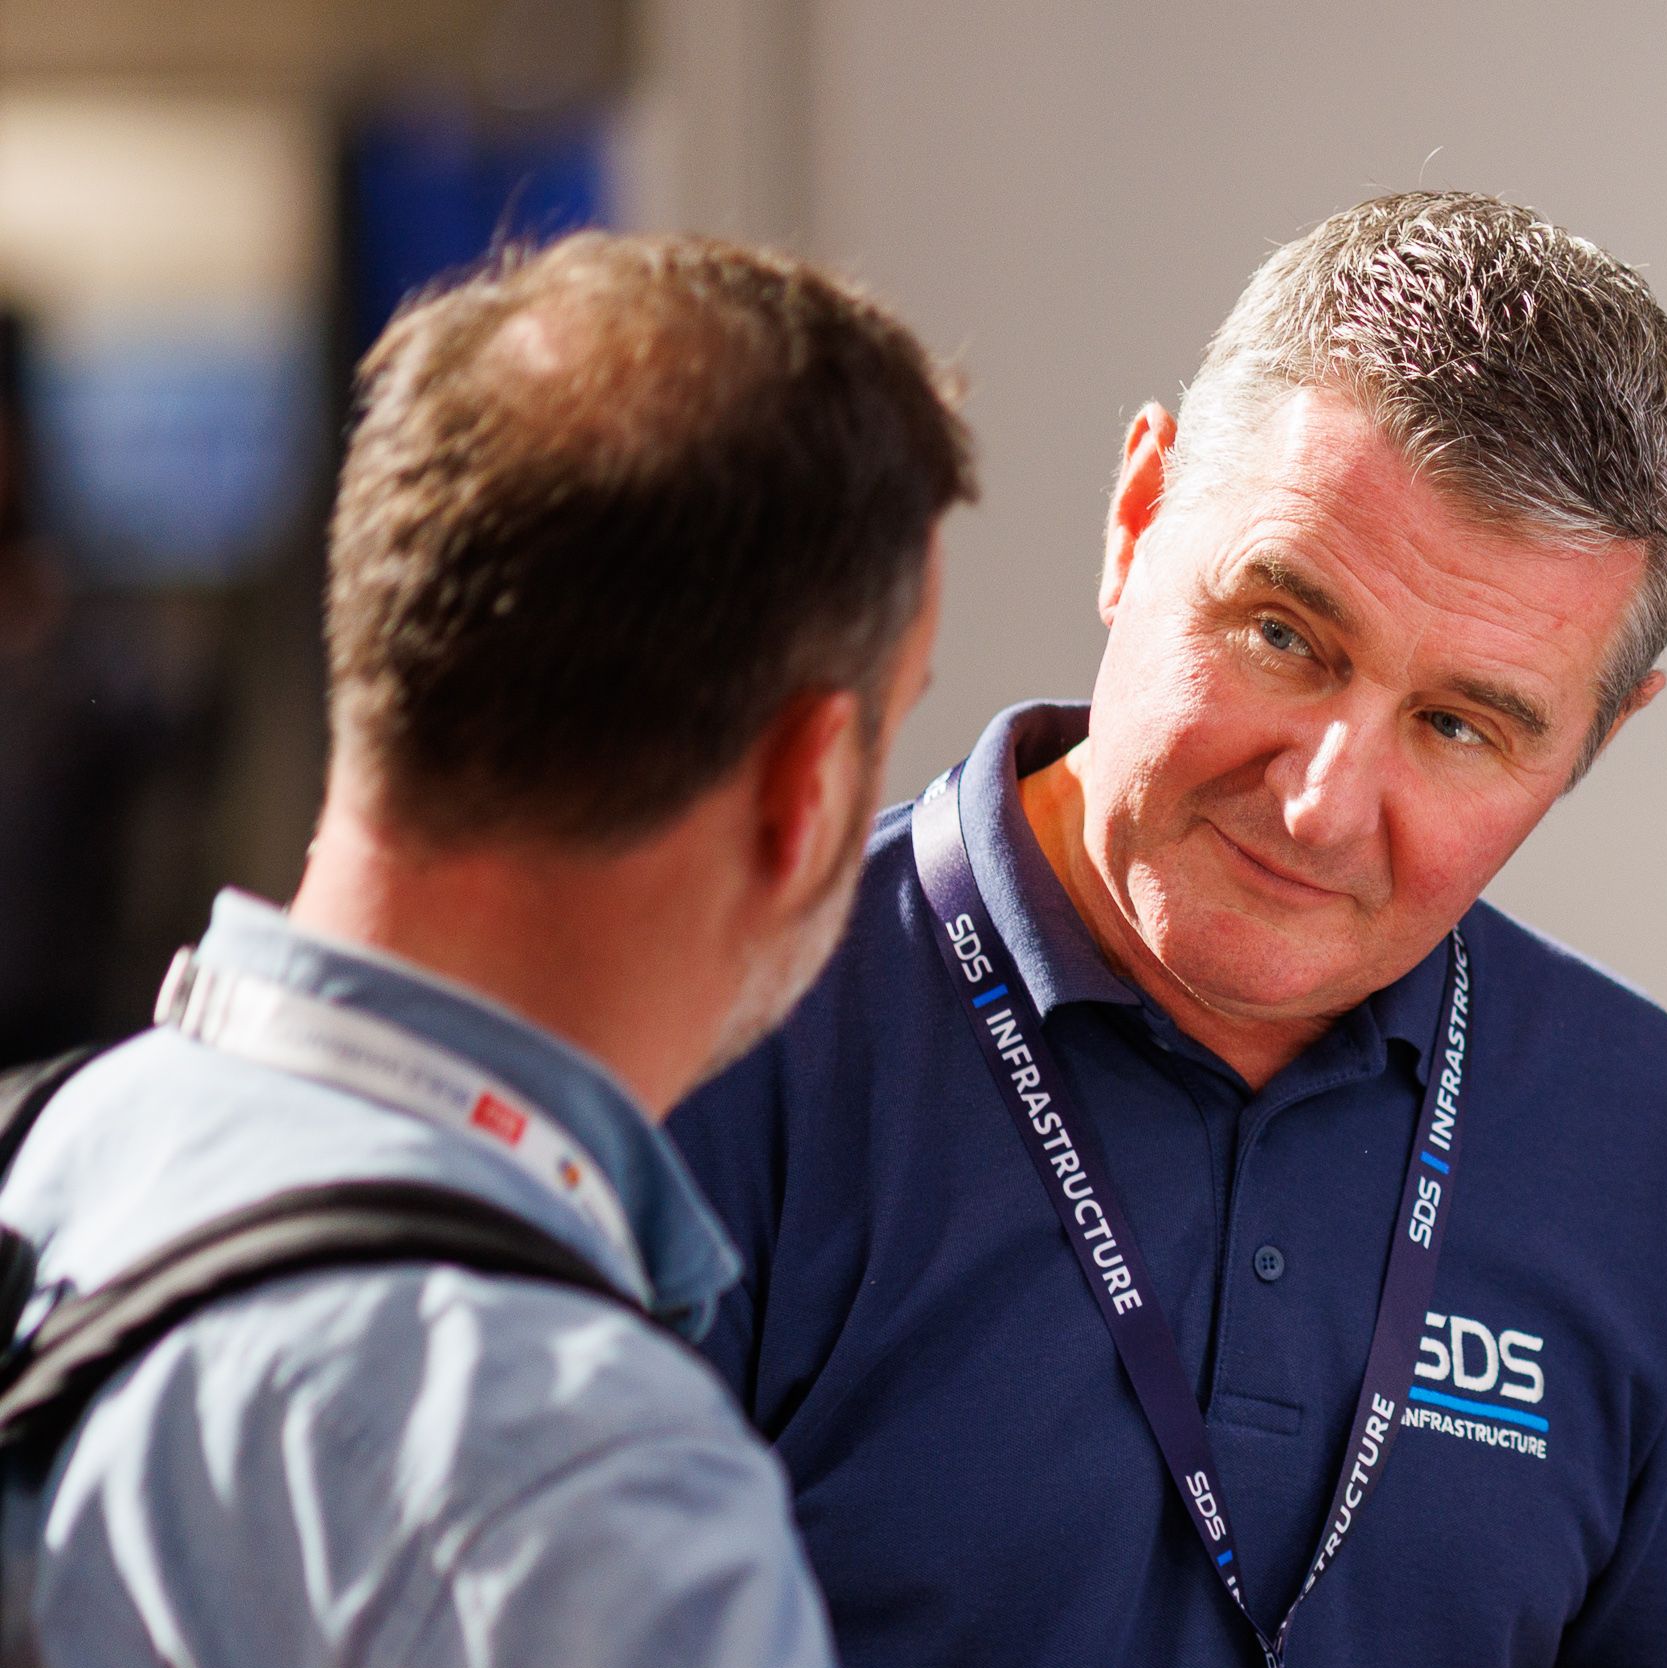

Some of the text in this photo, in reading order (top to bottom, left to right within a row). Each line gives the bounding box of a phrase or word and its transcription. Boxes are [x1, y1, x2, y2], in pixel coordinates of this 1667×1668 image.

[946, 913, 1143, 1315] SDS INFRASTRUCTURE
[1409, 920, 1470, 1250] SDS INFRASTRUCT
[1414, 1311, 1545, 1404] SDS
[1185, 1470, 1227, 1542] SDS
